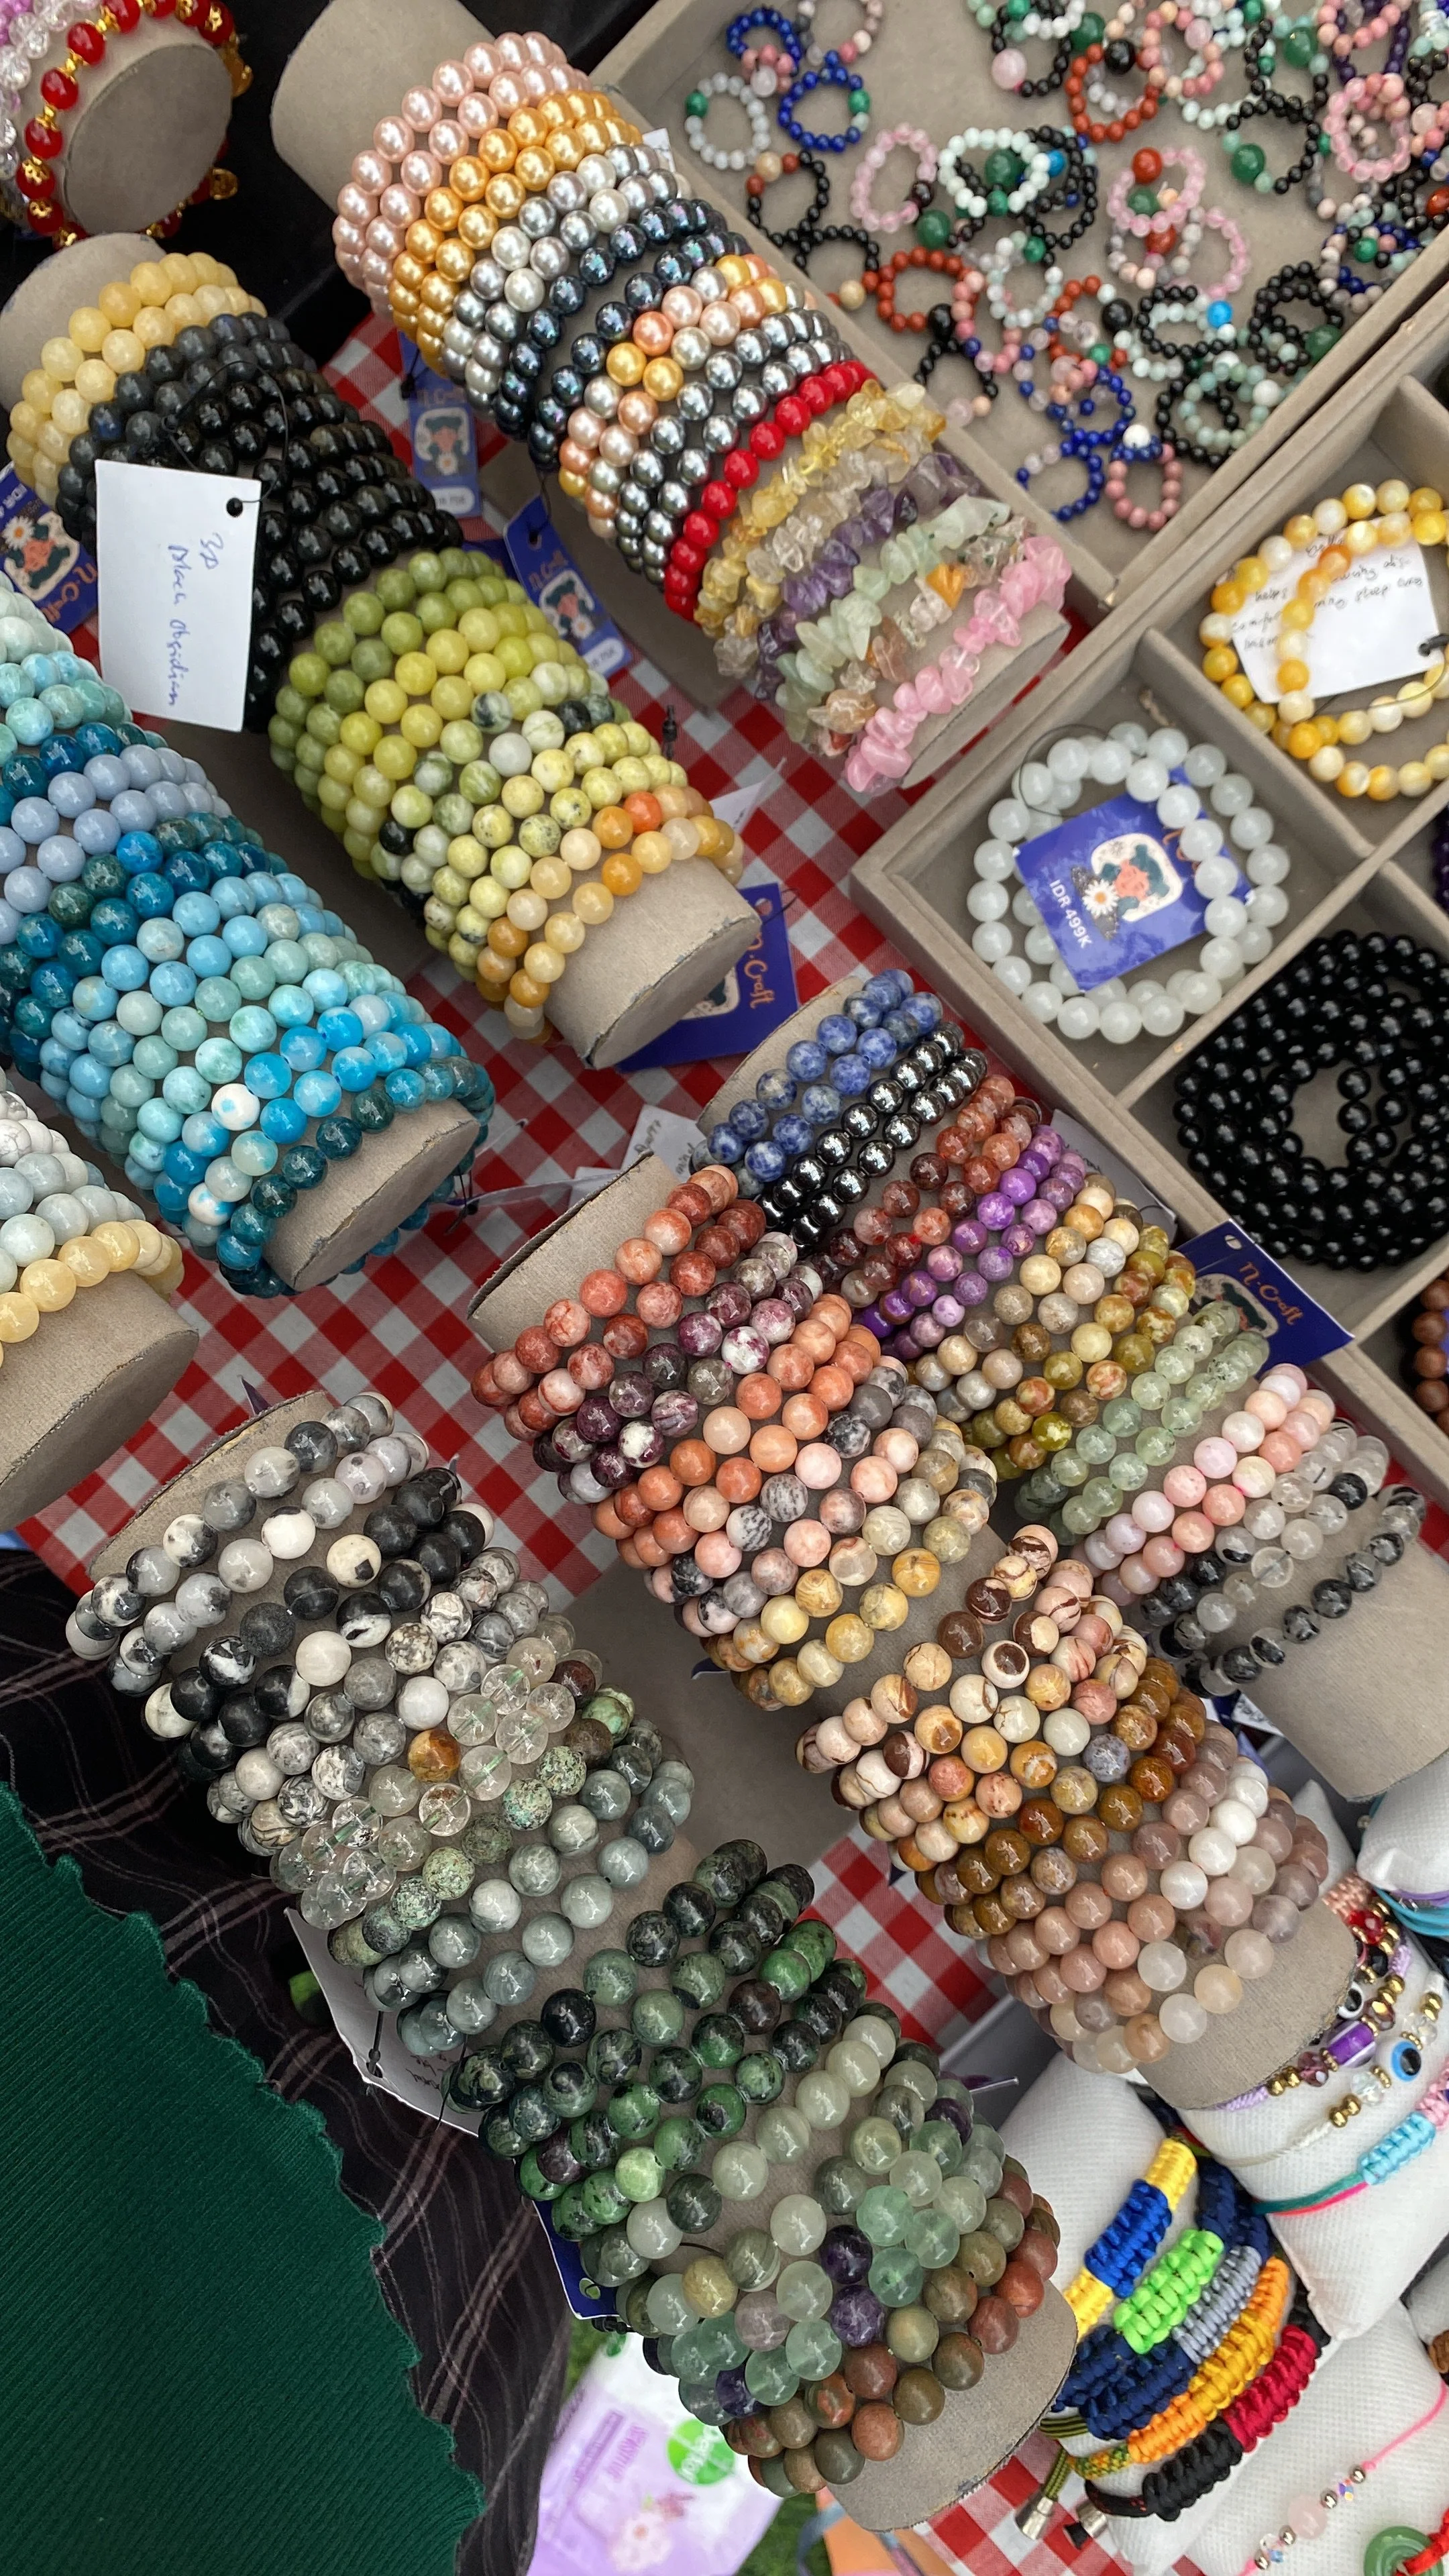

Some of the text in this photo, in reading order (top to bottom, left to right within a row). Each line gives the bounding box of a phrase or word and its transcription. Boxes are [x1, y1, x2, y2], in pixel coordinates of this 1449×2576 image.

[166, 619, 191, 706] Obsidian
[1049, 879, 1093, 949] IDR 499K
